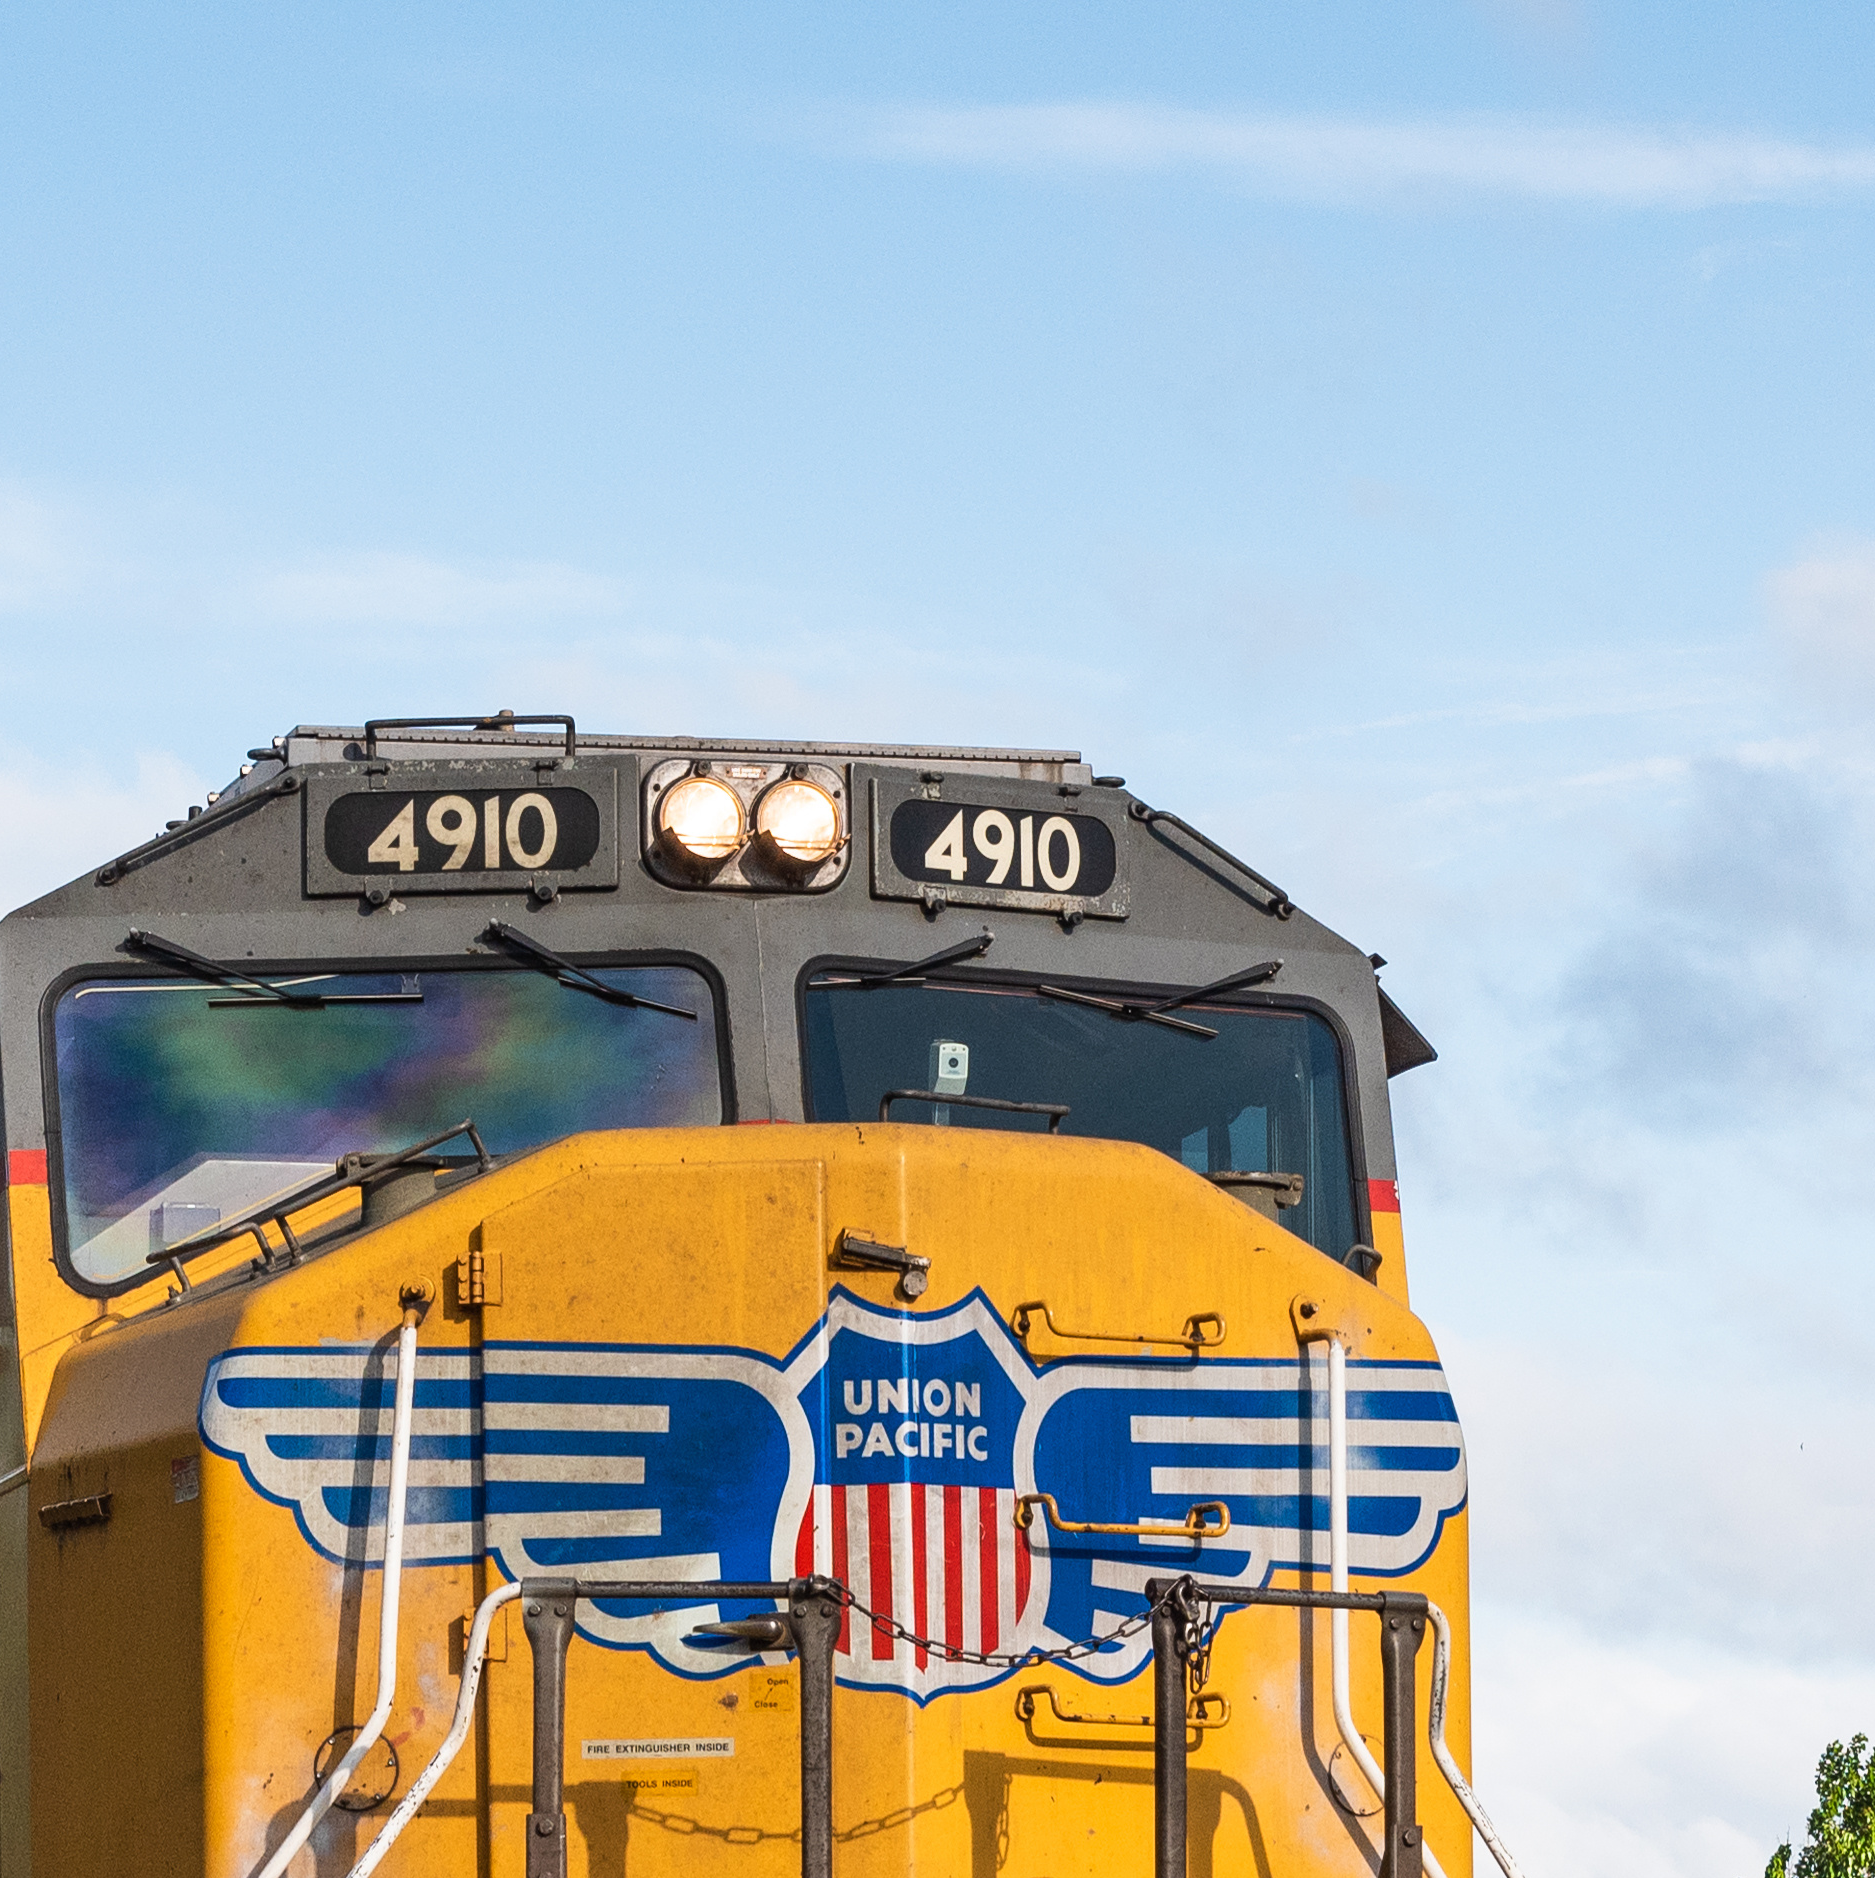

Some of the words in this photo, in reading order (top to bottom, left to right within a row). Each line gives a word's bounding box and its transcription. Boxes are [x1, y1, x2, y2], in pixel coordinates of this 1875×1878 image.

[368, 792, 558, 871] 4910
[925, 808, 1081, 892] 4910
[843, 1377, 981, 1418] UNION
[836, 1420, 988, 1462] PACIFIC
[766, 1677, 789, 1687] Open
[754, 1700, 778, 1708] Close
[587, 1745, 610, 1754] FIRE
[615, 1743, 691, 1753] EXTINGUISHER
[695, 1742, 730, 1752] INSIDE
[626, 1780, 657, 1789] TOOLS
[662, 1779, 693, 1788] INSIDE
